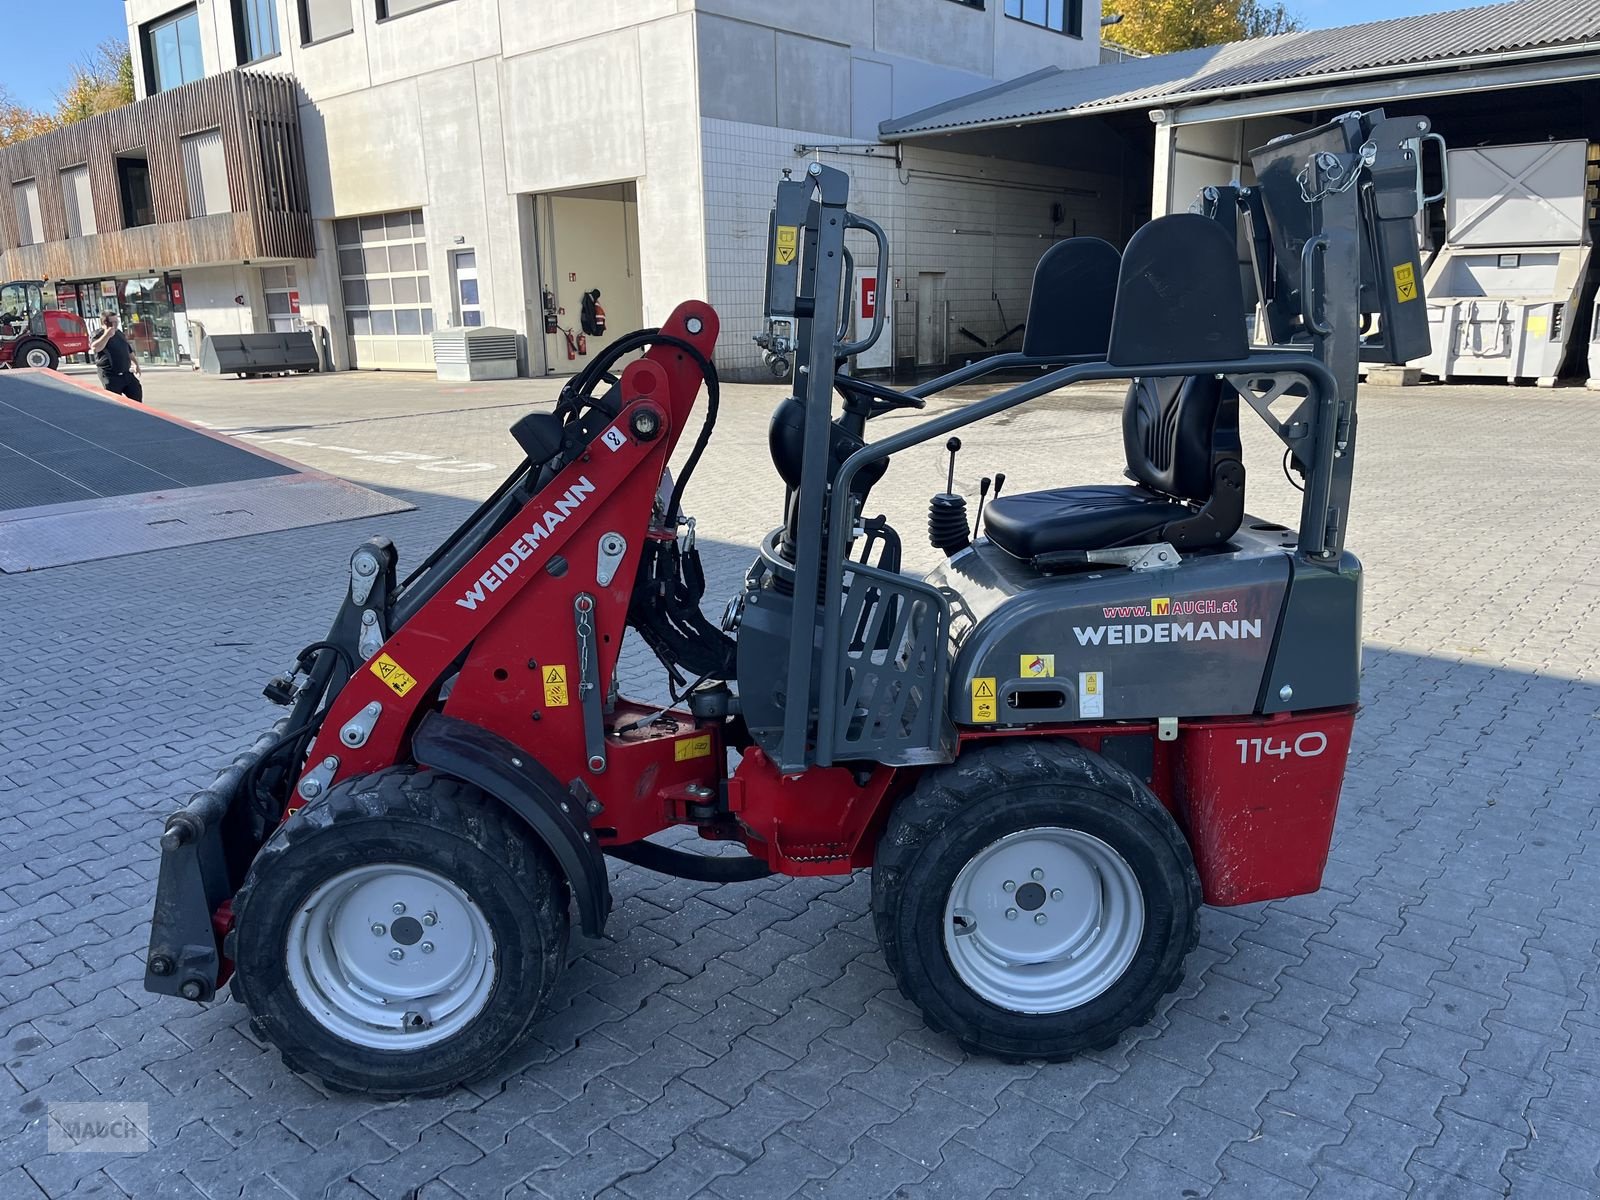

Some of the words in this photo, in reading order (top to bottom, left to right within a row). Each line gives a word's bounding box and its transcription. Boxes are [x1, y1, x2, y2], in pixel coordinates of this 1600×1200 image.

[455, 475, 596, 610] WEIDEMANN
[1103, 599, 1237, 618] www.MAUCH.at
[1073, 619, 1261, 646] WEIDEMANN
[1236, 731, 1328, 764] 1140
